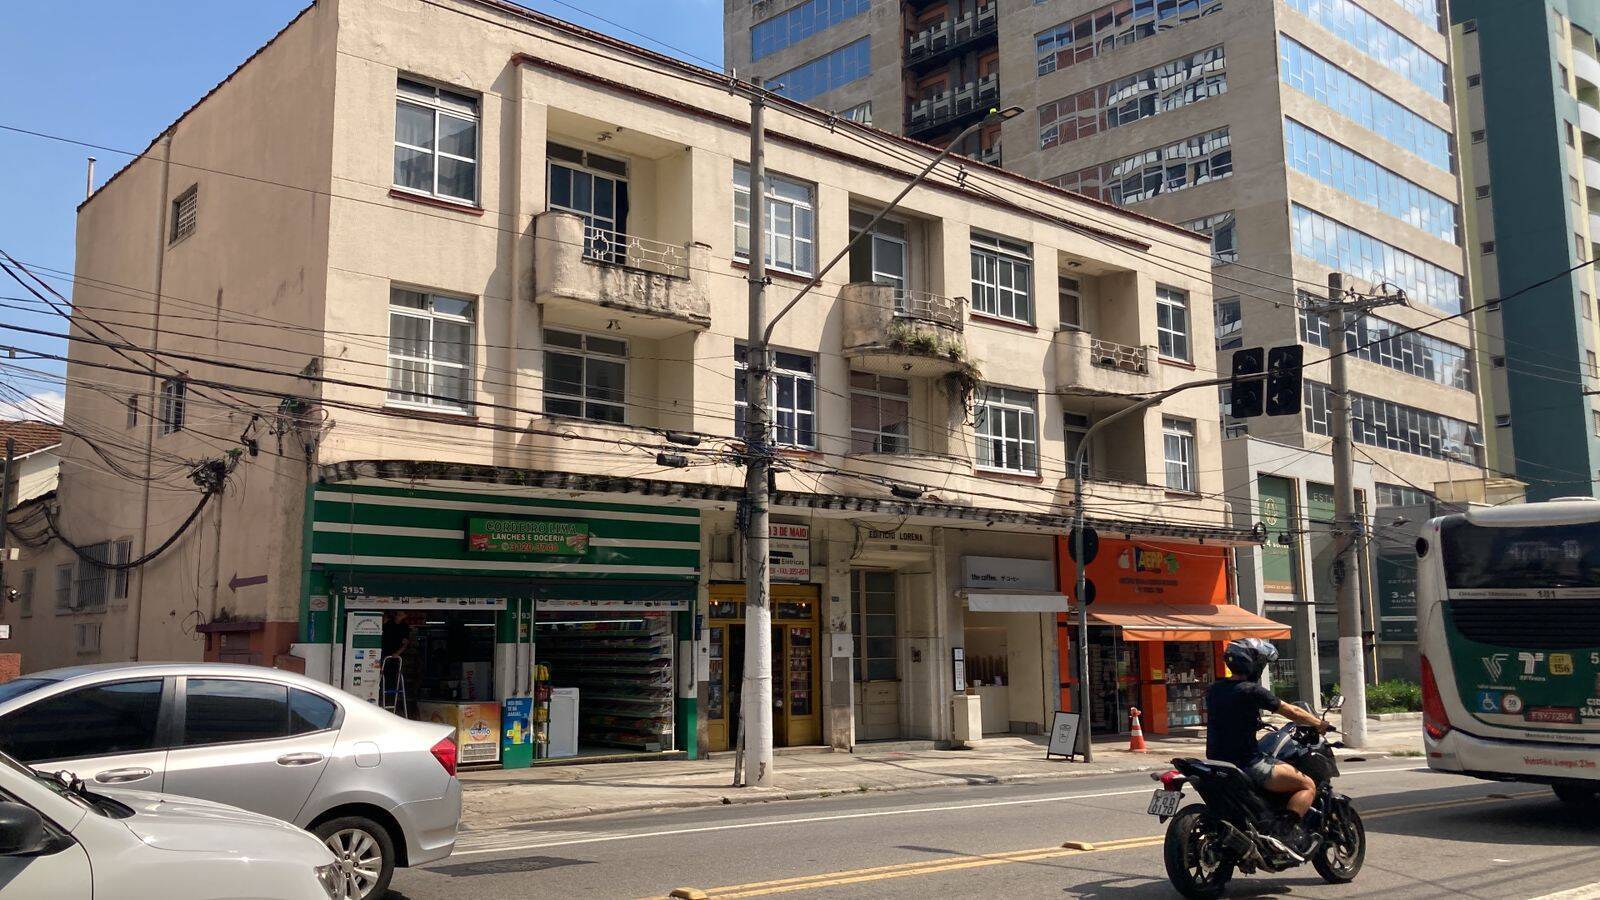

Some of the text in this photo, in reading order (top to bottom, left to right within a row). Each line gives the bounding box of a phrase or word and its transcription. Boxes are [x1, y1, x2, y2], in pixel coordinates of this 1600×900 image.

[486, 520, 578, 535] CORDEIRO LIMA
[780, 526, 788, 537] DE
[790, 527, 807, 538] MAIO
[492, 533, 526, 541] LANCHES
[534, 534, 565, 542] DOCERIA
[900, 531, 923, 541] LORENA
[971, 573, 980, 581] the
[1391, 591, 1400, 599] 3
[512, 611, 531, 619] 393
[1554, 663, 1570, 673] 156
